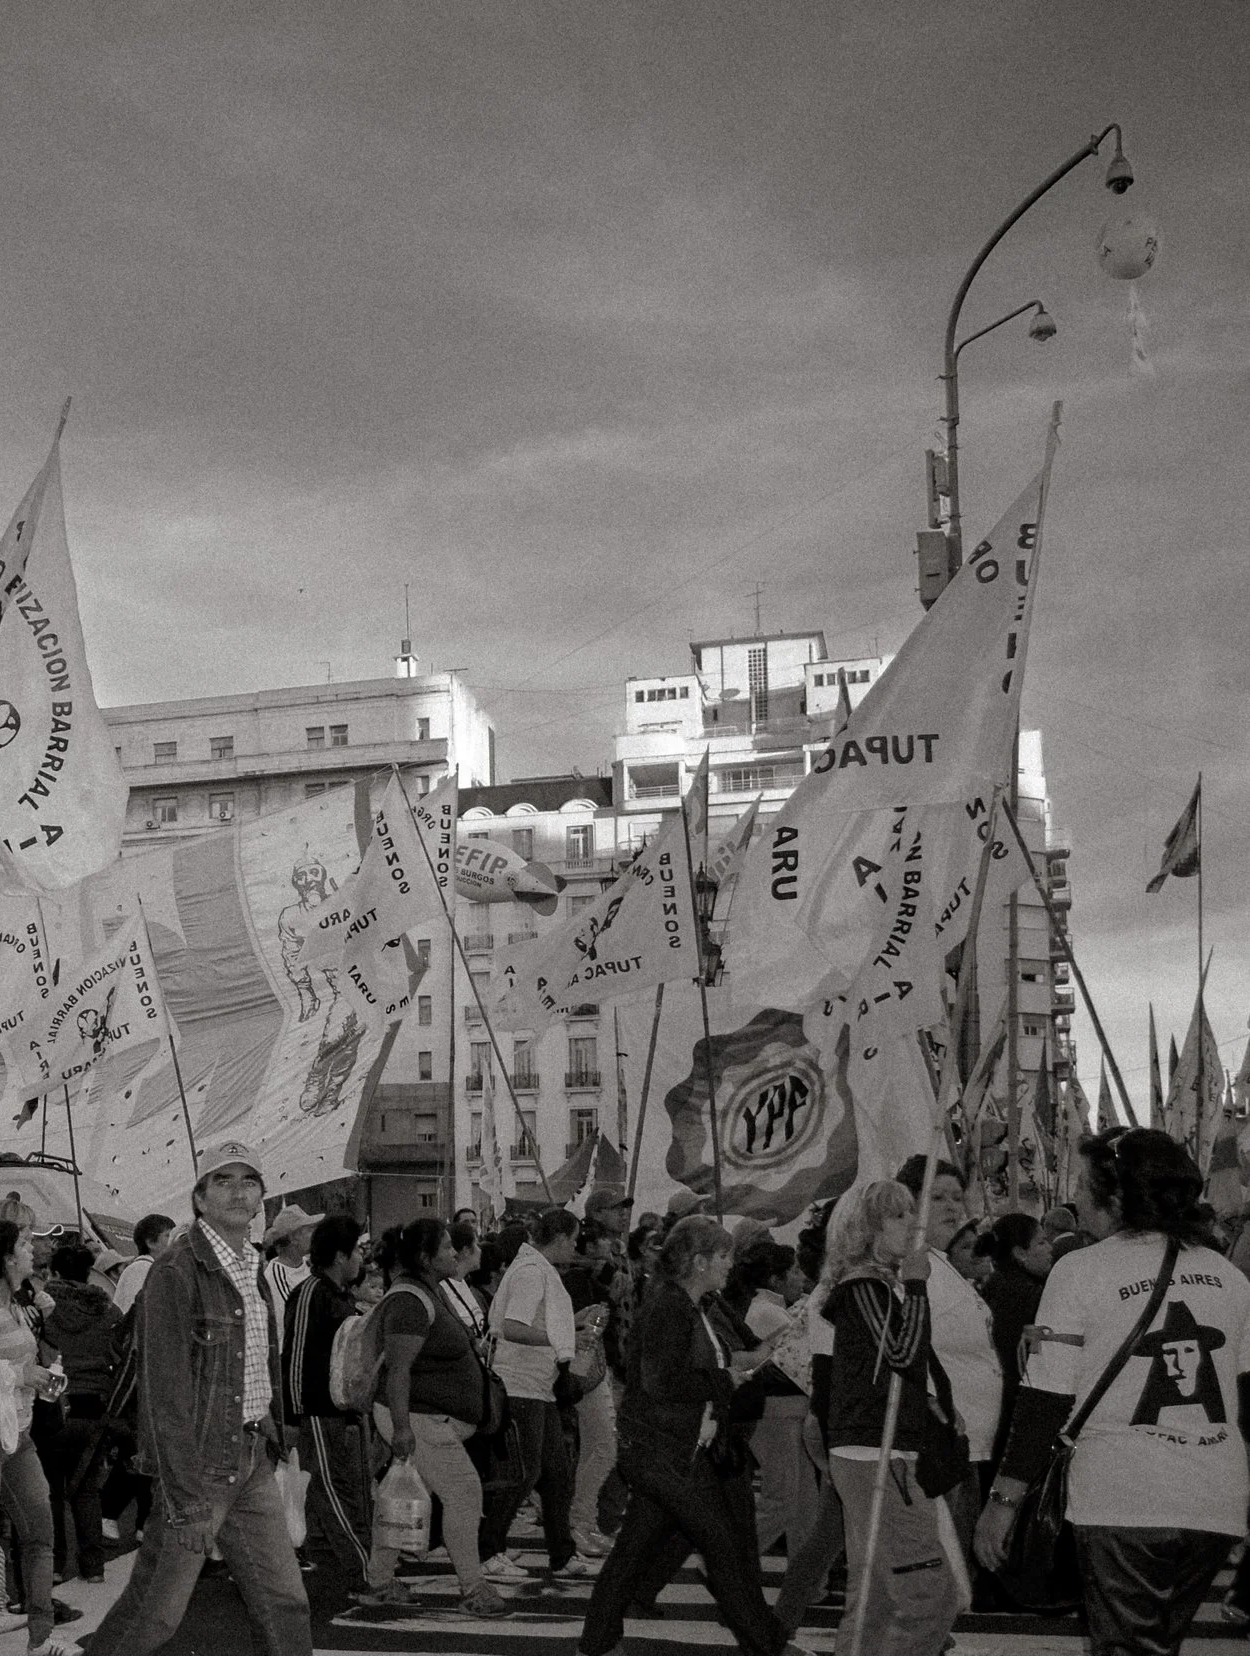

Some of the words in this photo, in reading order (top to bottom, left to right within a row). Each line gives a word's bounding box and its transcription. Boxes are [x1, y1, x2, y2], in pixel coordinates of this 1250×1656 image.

[17, 699, 73, 812] BARRIAL
[872, 870, 921, 968] BARRIAL
[743, 1075, 810, 1155] YPF
[1180, 1273, 1223, 1289] AIRES
